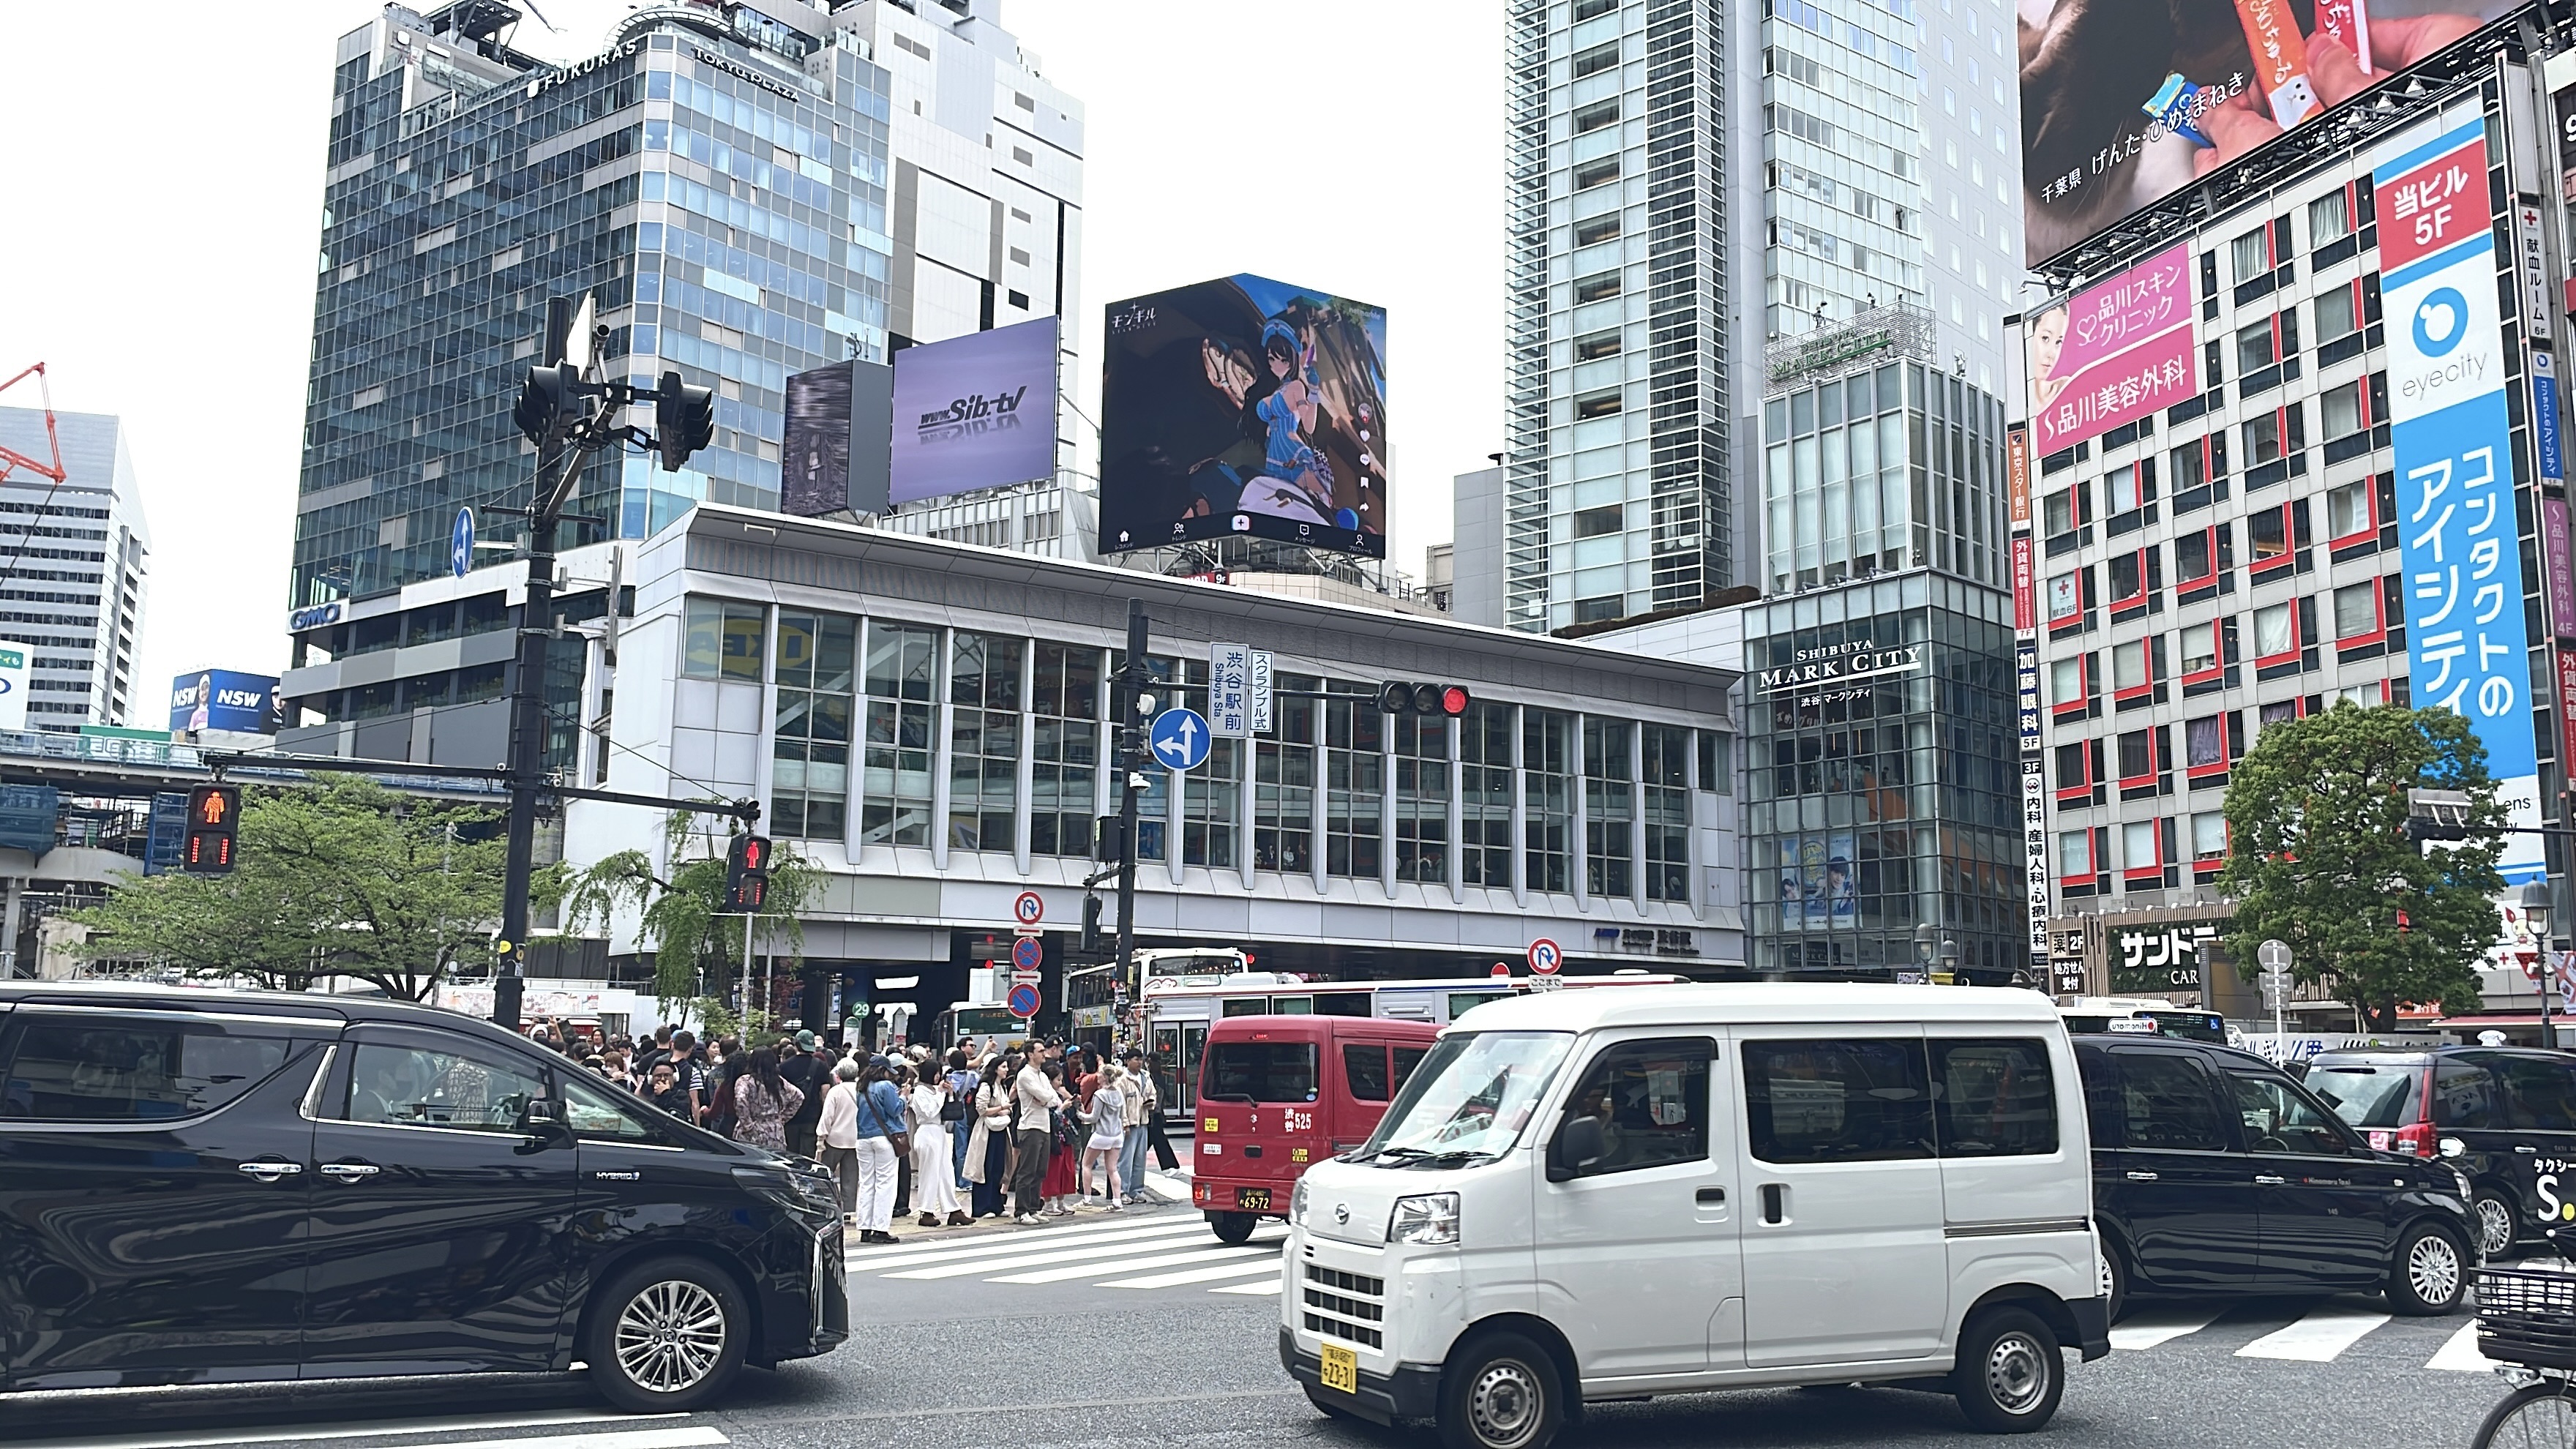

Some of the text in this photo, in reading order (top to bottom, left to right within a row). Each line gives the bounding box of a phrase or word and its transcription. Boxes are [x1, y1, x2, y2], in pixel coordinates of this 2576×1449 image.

[544, 38, 637, 91] FUKURAS
[694, 46, 801, 102] TOKYU PLAZA
[2040, 167, 2083, 204] 千葉県
[2394, 165, 2469, 221] 当ビル
[2414, 204, 2453, 246] 5F
[2098, 266, 2182, 323] 品川スキン
[2526, 238, 2545, 321] 献血ルーム
[1112, 306, 1156, 328] モンギル
[2100, 296, 2174, 348] クリニック
[2534, 326, 2546, 337] 6F
[1772, 329, 1888, 377] MARK CITY
[2403, 351, 2488, 401] eyecity
[918, 386, 1028, 426] www.Sib.tv
[2057, 354, 2187, 436] 品川美容外科
[2012, 446, 2025, 519] 東京スター銀行
[1215, 574, 1226, 585] 9F
[2015, 540, 2029, 588] 外貨両替
[2551, 523, 2570, 615] 品川美容外科
[2407, 457, 2471, 716] アイシティ
[2462, 445, 2515, 717] コンタクトの
[291, 604, 341, 629] GMO
[2558, 623, 2573, 634] 4F
[2020, 629, 2032, 638] 7F
[1797, 639, 1873, 662] SHIBUYA
[1759, 647, 1922, 688] MARK CITY
[172, 686, 198, 708] NSW
[217, 689, 262, 708] NSW
[1213, 662, 1224, 721] Shibuya Sta.
[1225, 651, 1243, 730] 渋谷駅前
[1254, 654, 1268, 729] スクランブル式
[1800, 689, 1871, 708] 渋谷 マークシティ
[2018, 653, 2038, 733] 加藤眼科
[2023, 738, 2038, 749] 5F
[2023, 763, 2040, 774] 3F
[2026, 797, 2043, 824] 内科
[2028, 829, 2048, 948] 産婦人科・心療内科
[2053, 935, 2066, 954] 薬
[2070, 936, 2083, 951] 2F
[1531, 978, 1561, 986] ここまで
[2053, 960, 2085, 975] 処方せん
[2062, 976, 2079, 991] 受付
[2170, 970, 2200, 985] CAR
[855, 1004, 870, 1016] 29
[1284, 1107, 1295, 1133] 渋谷
[1295, 1112, 1312, 1130] 525
[2534, 1158, 2576, 1173] タクシー
